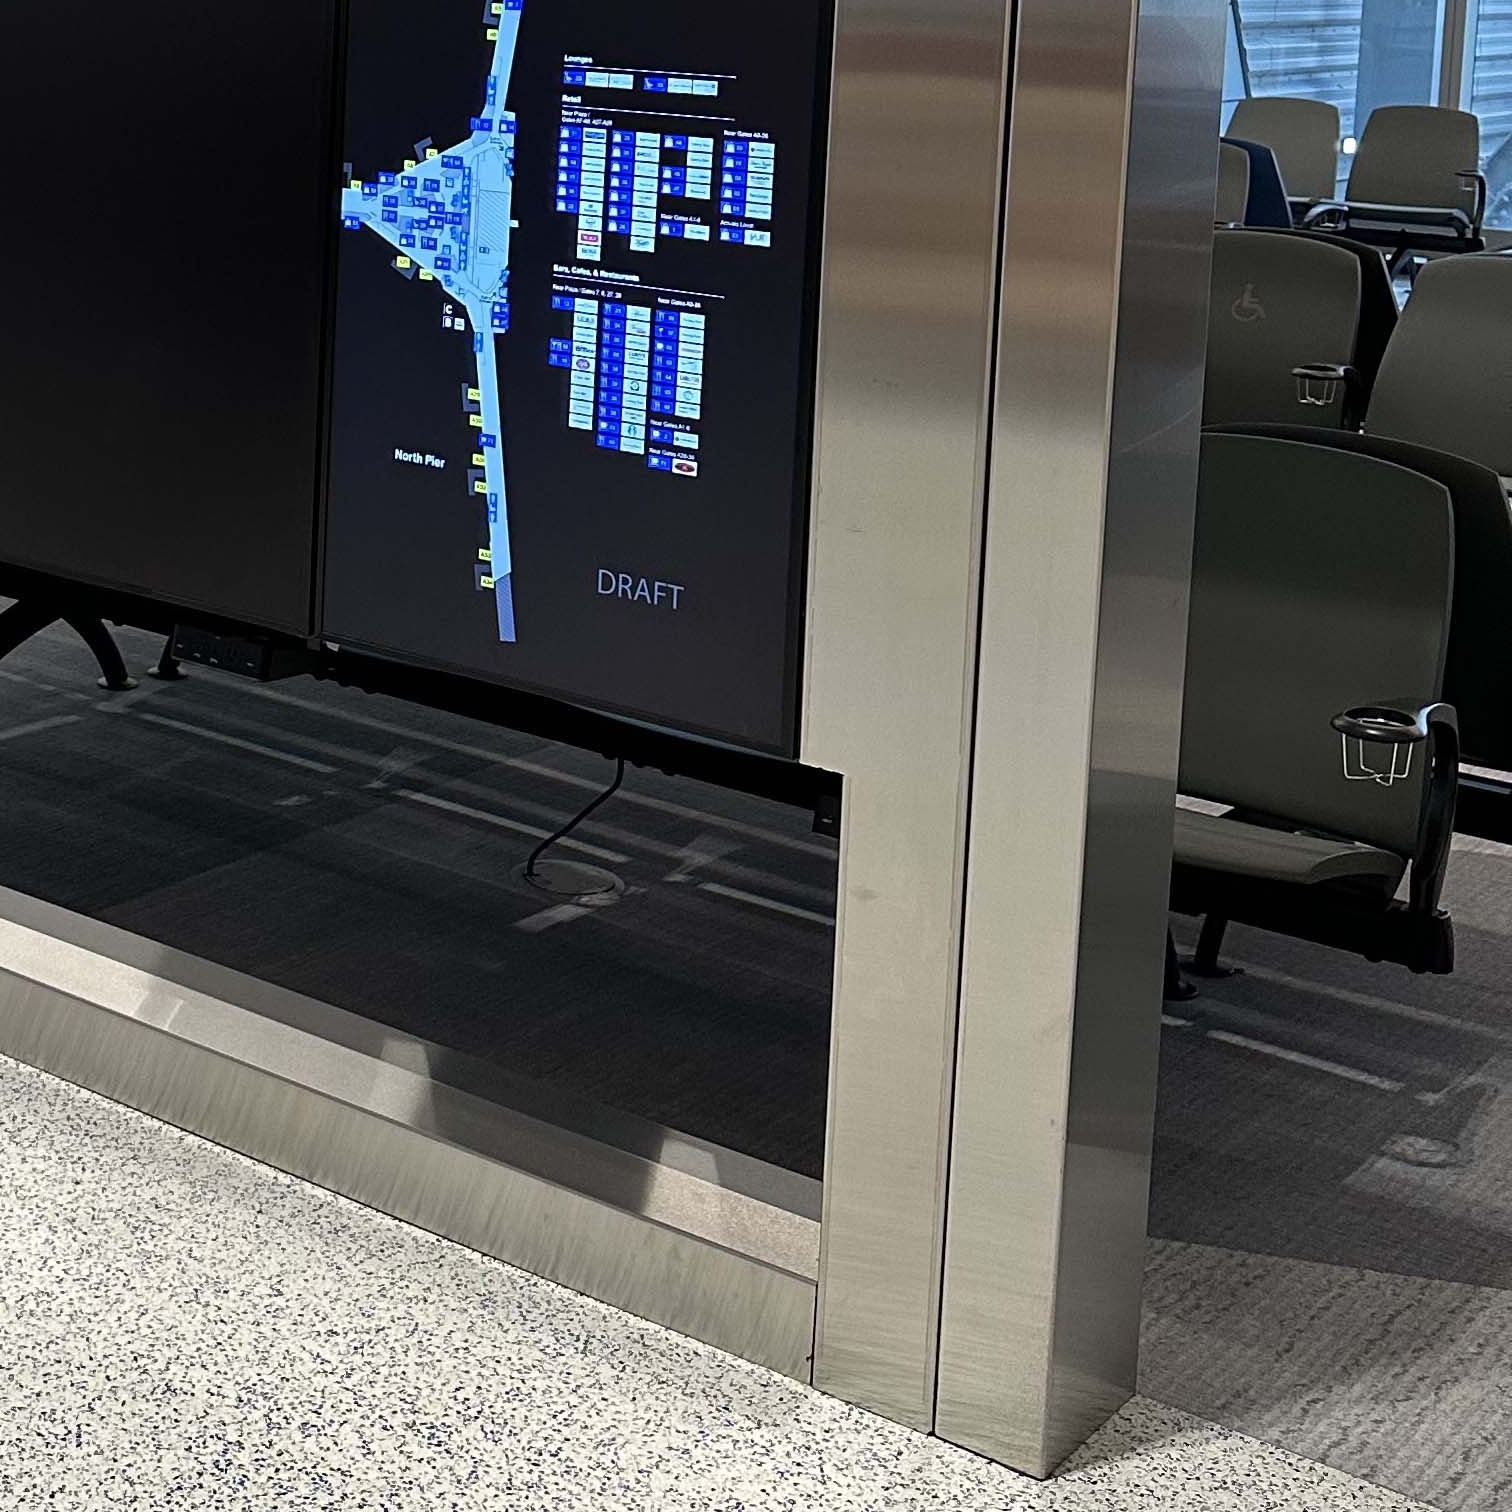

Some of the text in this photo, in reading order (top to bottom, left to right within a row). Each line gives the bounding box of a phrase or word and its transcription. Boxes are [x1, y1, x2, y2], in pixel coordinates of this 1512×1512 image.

[394, 448, 446, 469] North Pier
[597, 568, 685, 610] DRAFT
